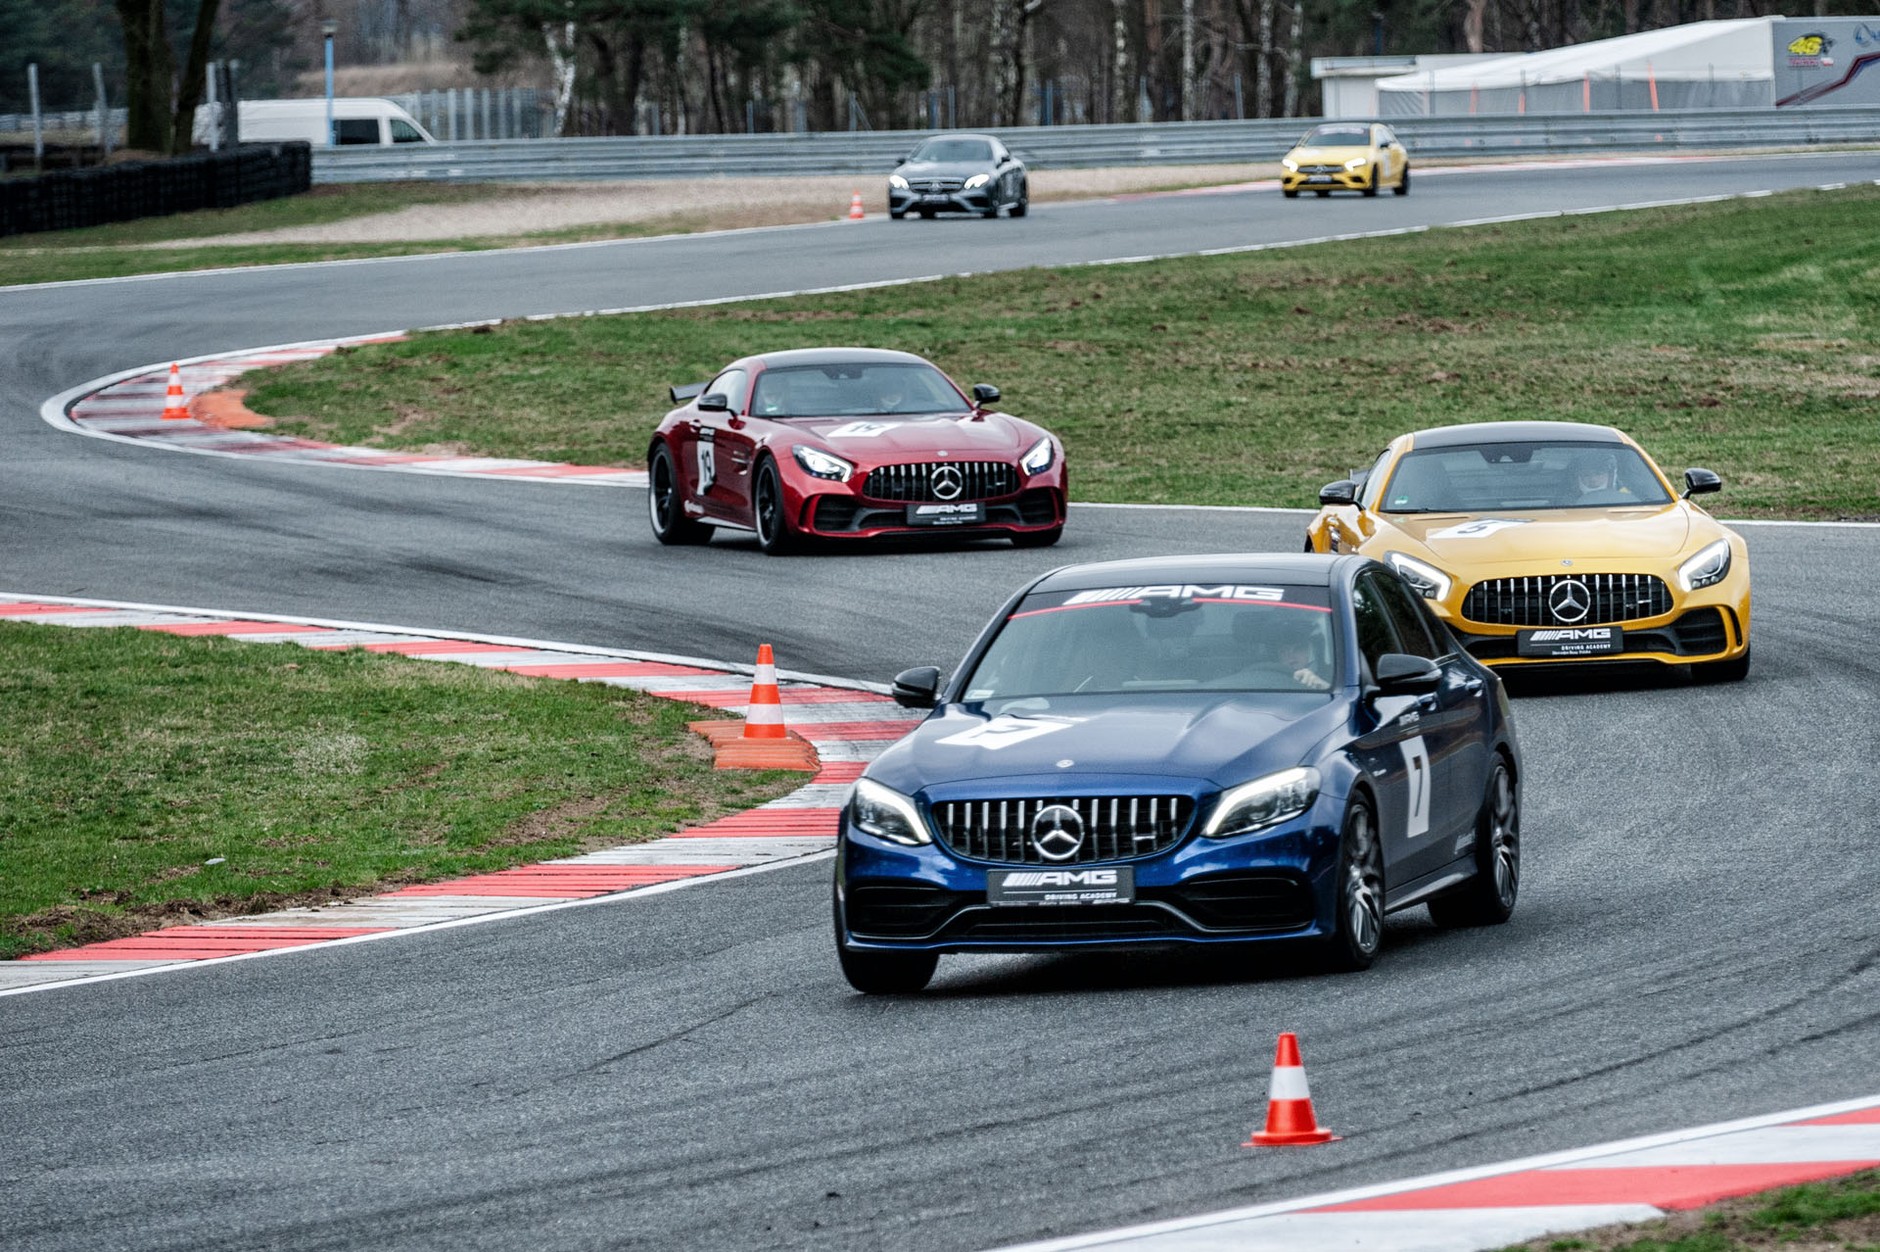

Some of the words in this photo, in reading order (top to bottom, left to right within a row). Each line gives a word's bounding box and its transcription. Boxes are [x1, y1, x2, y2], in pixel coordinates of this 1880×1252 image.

[935, 503, 977, 514] AMG
[1457, 521, 1499, 534] 5
[1128, 585, 1285, 601] AMG
[1556, 628, 1611, 641] AMG
[1035, 870, 1117, 886] AMG
